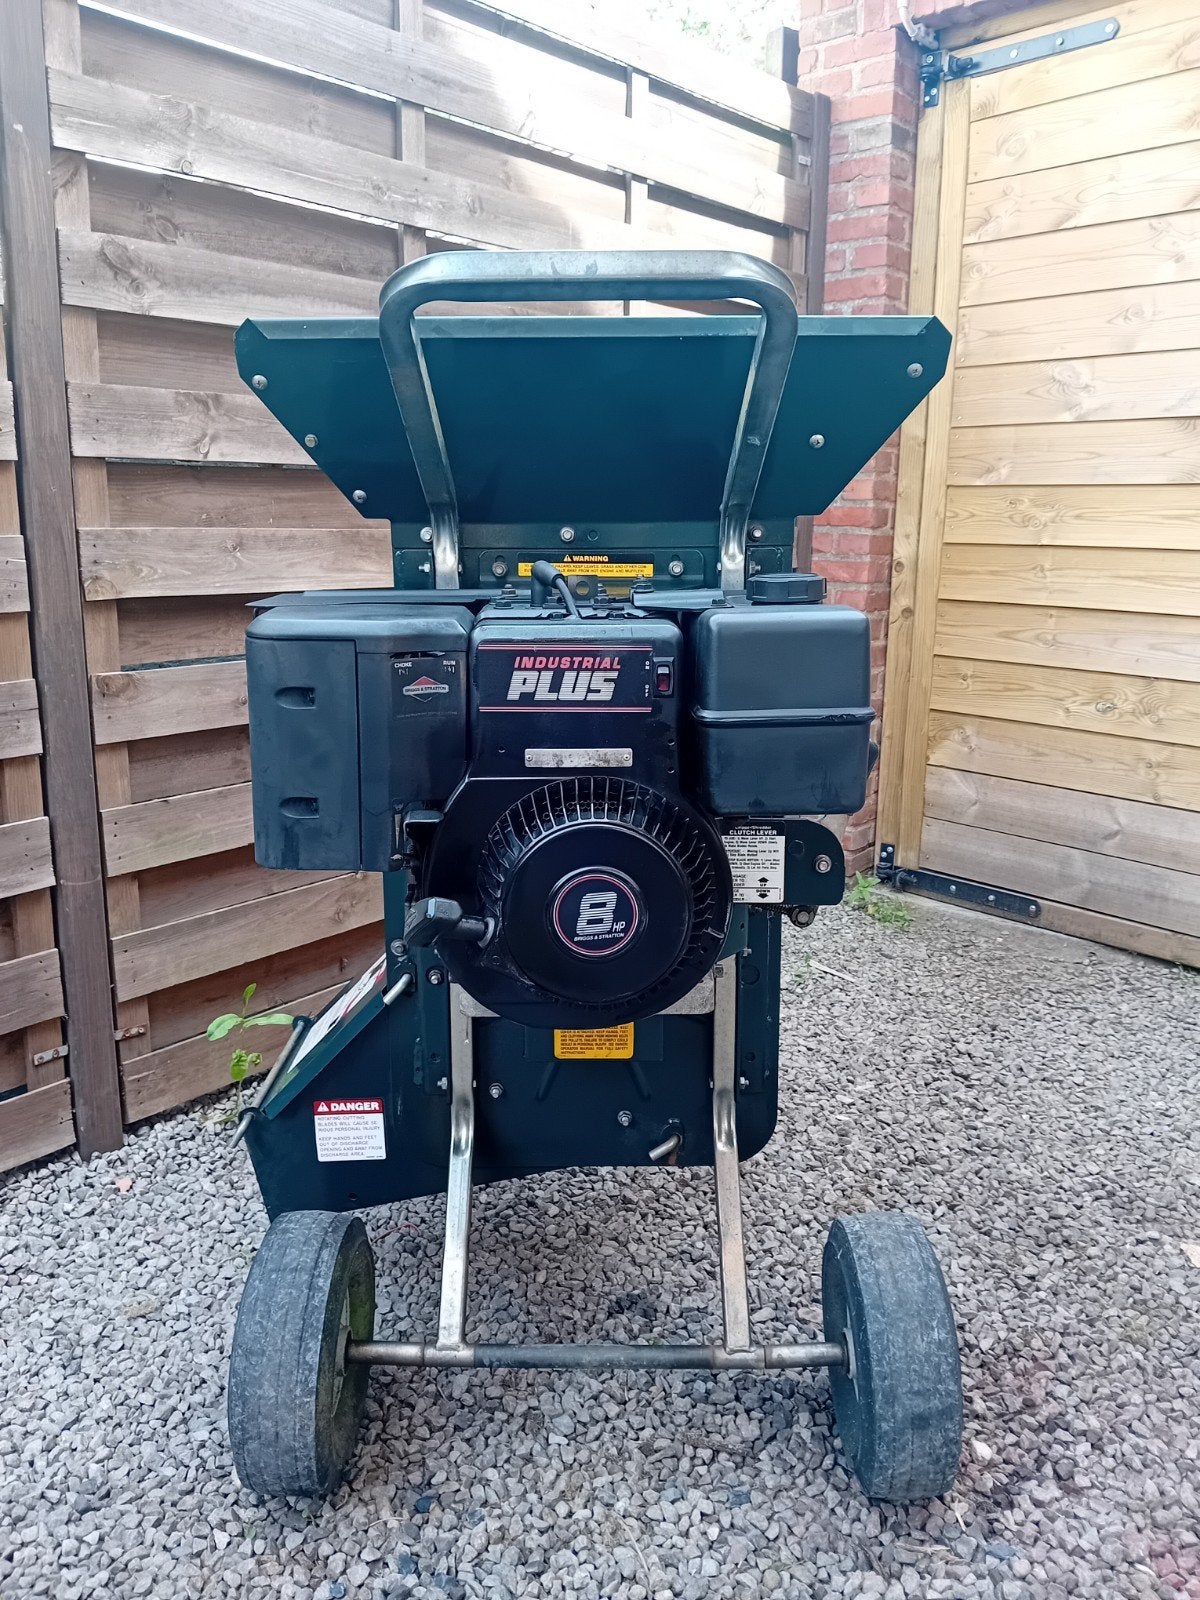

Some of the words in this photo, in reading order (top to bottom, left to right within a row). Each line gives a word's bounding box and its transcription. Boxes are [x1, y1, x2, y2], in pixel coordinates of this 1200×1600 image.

[514, 656, 621, 669] INDUSTRIAL
[506, 670, 619, 700] PLUS
[576, 892, 617, 936] 8
[612, 921, 625, 932] HP
[330, 1102, 380, 1112] DANGER
